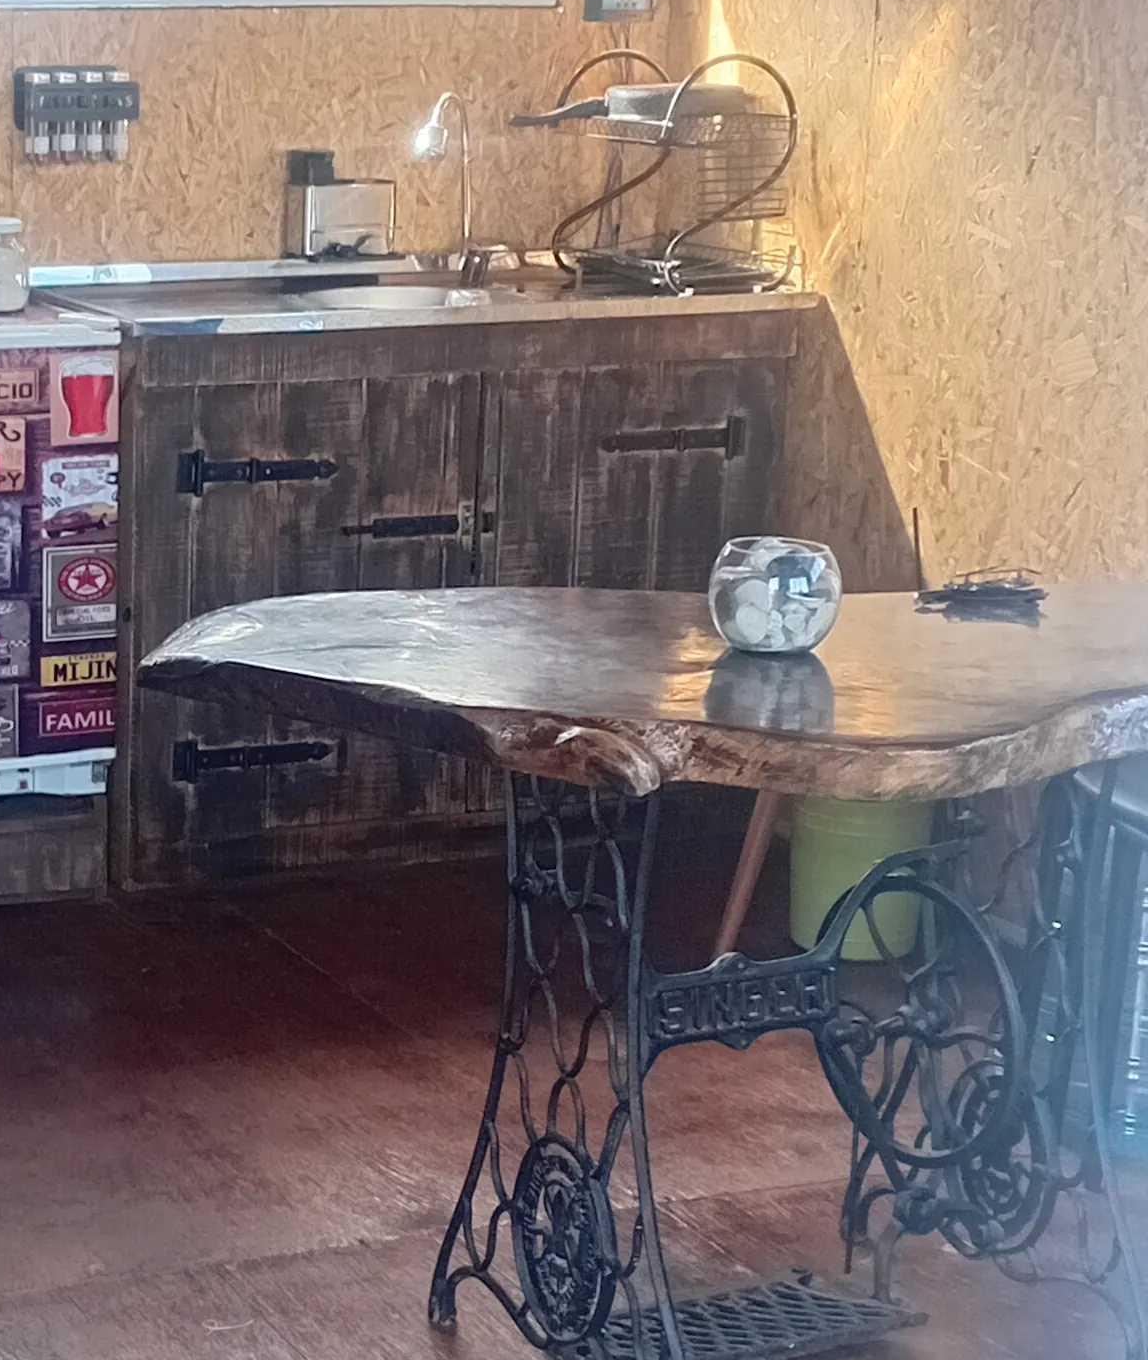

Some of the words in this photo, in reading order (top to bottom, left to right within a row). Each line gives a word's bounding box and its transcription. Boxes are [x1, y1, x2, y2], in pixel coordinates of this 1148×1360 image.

[54, 659, 117, 682] MIJIN
[45, 709, 116, 731] FAMIL
[658, 972, 826, 1038] SINGER
